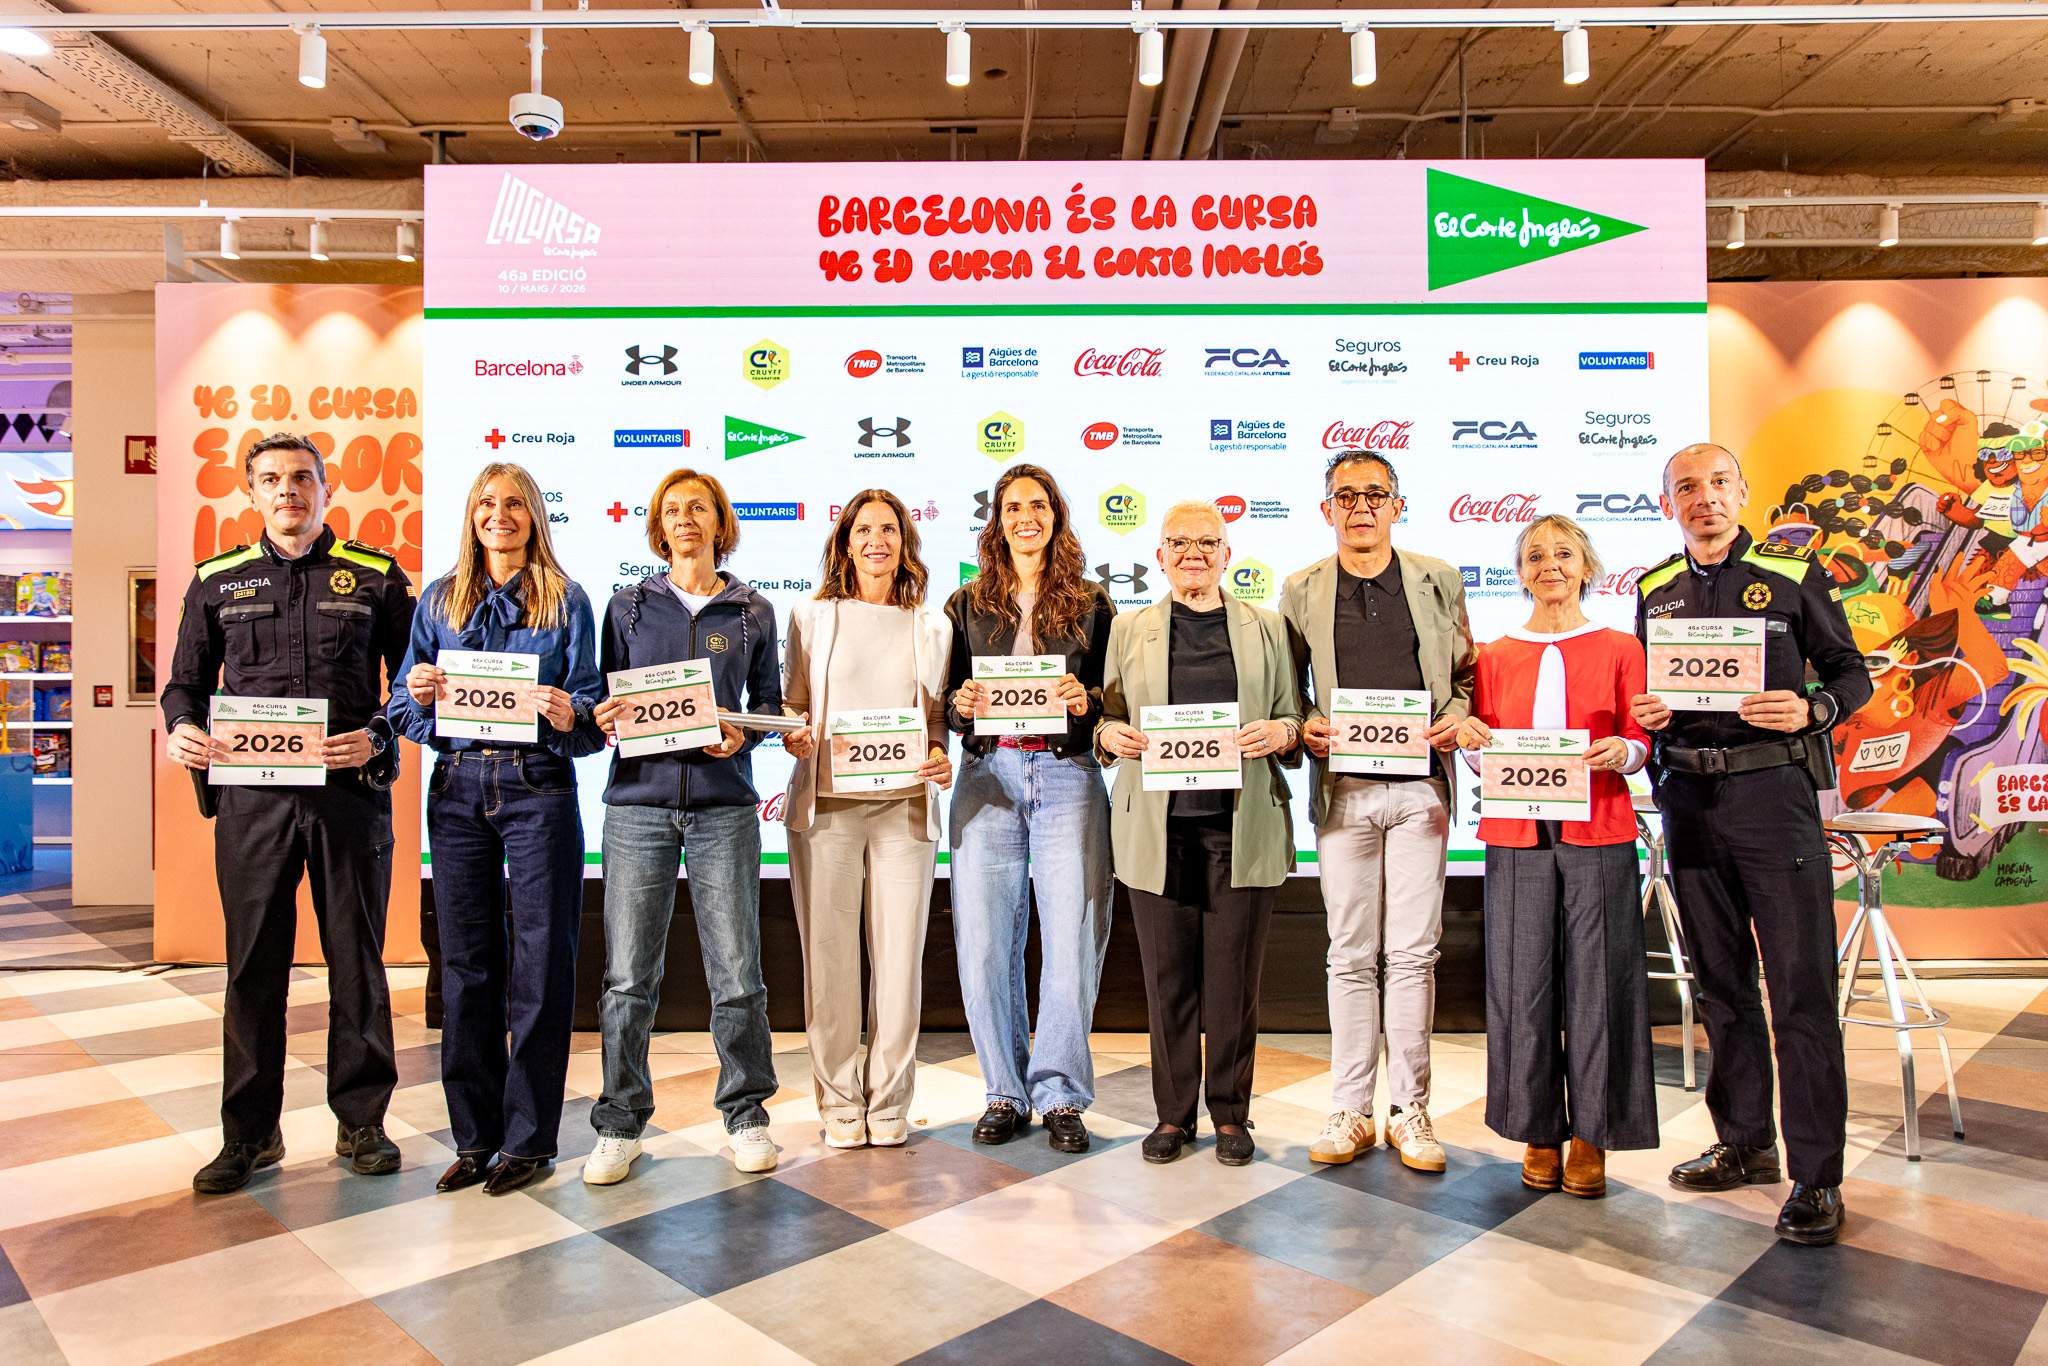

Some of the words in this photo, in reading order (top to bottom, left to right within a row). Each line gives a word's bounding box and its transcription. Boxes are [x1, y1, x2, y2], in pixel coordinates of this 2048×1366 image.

[818, 194, 1051, 237] BARCELONA
[1065, 183, 1116, 234] ÉS
[1131, 195, 1177, 231] LA
[1192, 194, 1317, 231] CURSA
[1434, 212, 1460, 238] El
[1460, 213, 1516, 238] Corte
[1518, 207, 1600, 248] Inglés
[819, 249, 863, 282] 46
[873, 248, 913, 284] ED
[929, 249, 1033, 282] CURSA
[1044, 245, 1085, 280] EL
[1094, 245, 1193, 279] CORTE
[498, 270, 528, 281] 46a
[532, 266, 587, 281] EDICIÓ
[498, 285, 509, 294] 10
[520, 285, 548, 293] MAIG
[560, 285, 586, 293] 2026
[989, 348, 1023, 358] Aigües
[1026, 348, 1037, 356] de
[1335, 338, 1402, 356] Seguros
[853, 359, 878, 369] TMB
[989, 358, 1039, 366] Barcelona
[1074, 348, 1167, 377] Coca-Cola
[1205, 348, 1290, 368] FCA
[1328, 360, 1340, 372] El
[1341, 360, 1368, 372] Corte
[1369, 357, 1408, 376] Inglés
[1476, 356, 1506, 366] Creu
[1510, 355, 1540, 368] Roja
[1580, 356, 1647, 366] VOLUNTARIS
[475, 360, 566, 376] Barcelona
[972, 371, 994, 380] gestió
[995, 370, 1039, 379] responsable
[193, 384, 239, 419] 46
[250, 384, 298, 421] ED.
[308, 386, 418, 420] CURSA
[1237, 420, 1270, 431] Aigües
[1273, 421, 1285, 429] de
[1585, 411, 1651, 427] Seguros
[512, 433, 543, 444] Creu
[546, 432, 575, 446] Roja
[616, 434, 682, 443] VOLUNTARIS
[728, 432, 736, 441] El
[736, 432, 758, 442] Corte
[1089, 431, 1114, 440] TMB
[1238, 431, 1287, 439] Barcelona
[1322, 421, 1415, 450] Coca-Cola
[1452, 421, 1538, 440] FCA
[1579, 432, 1590, 444] El
[1591, 432, 1618, 444] Corte
[1619, 430, 1657, 448] Inglés
[1220, 443, 1242, 452] gestió
[1243, 443, 1287, 452] responsable
[1576, 494, 1661, 513] FCA
[220, 578, 271, 593] POLICIA
[748, 580, 779, 590] Creu
[784, 580, 812, 591] Roja
[1469, 590, 1490, 599] gestió
[1647, 599, 1685, 617] POLICIA
[1669, 658, 1739, 678] 2026
[454, 689, 516, 709] 2026
[991, 689, 1047, 706] 2026
[633, 699, 696, 724] 2026
[232, 734, 304, 752] 2026
[1348, 725, 1409, 744] 2026
[849, 743, 906, 762] 2026
[1160, 740, 1220, 759] 2026
[1501, 767, 1567, 787] 2026
[1998, 794, 2020, 814] ÉS
[1997, 862, 2033, 875] MARINA
